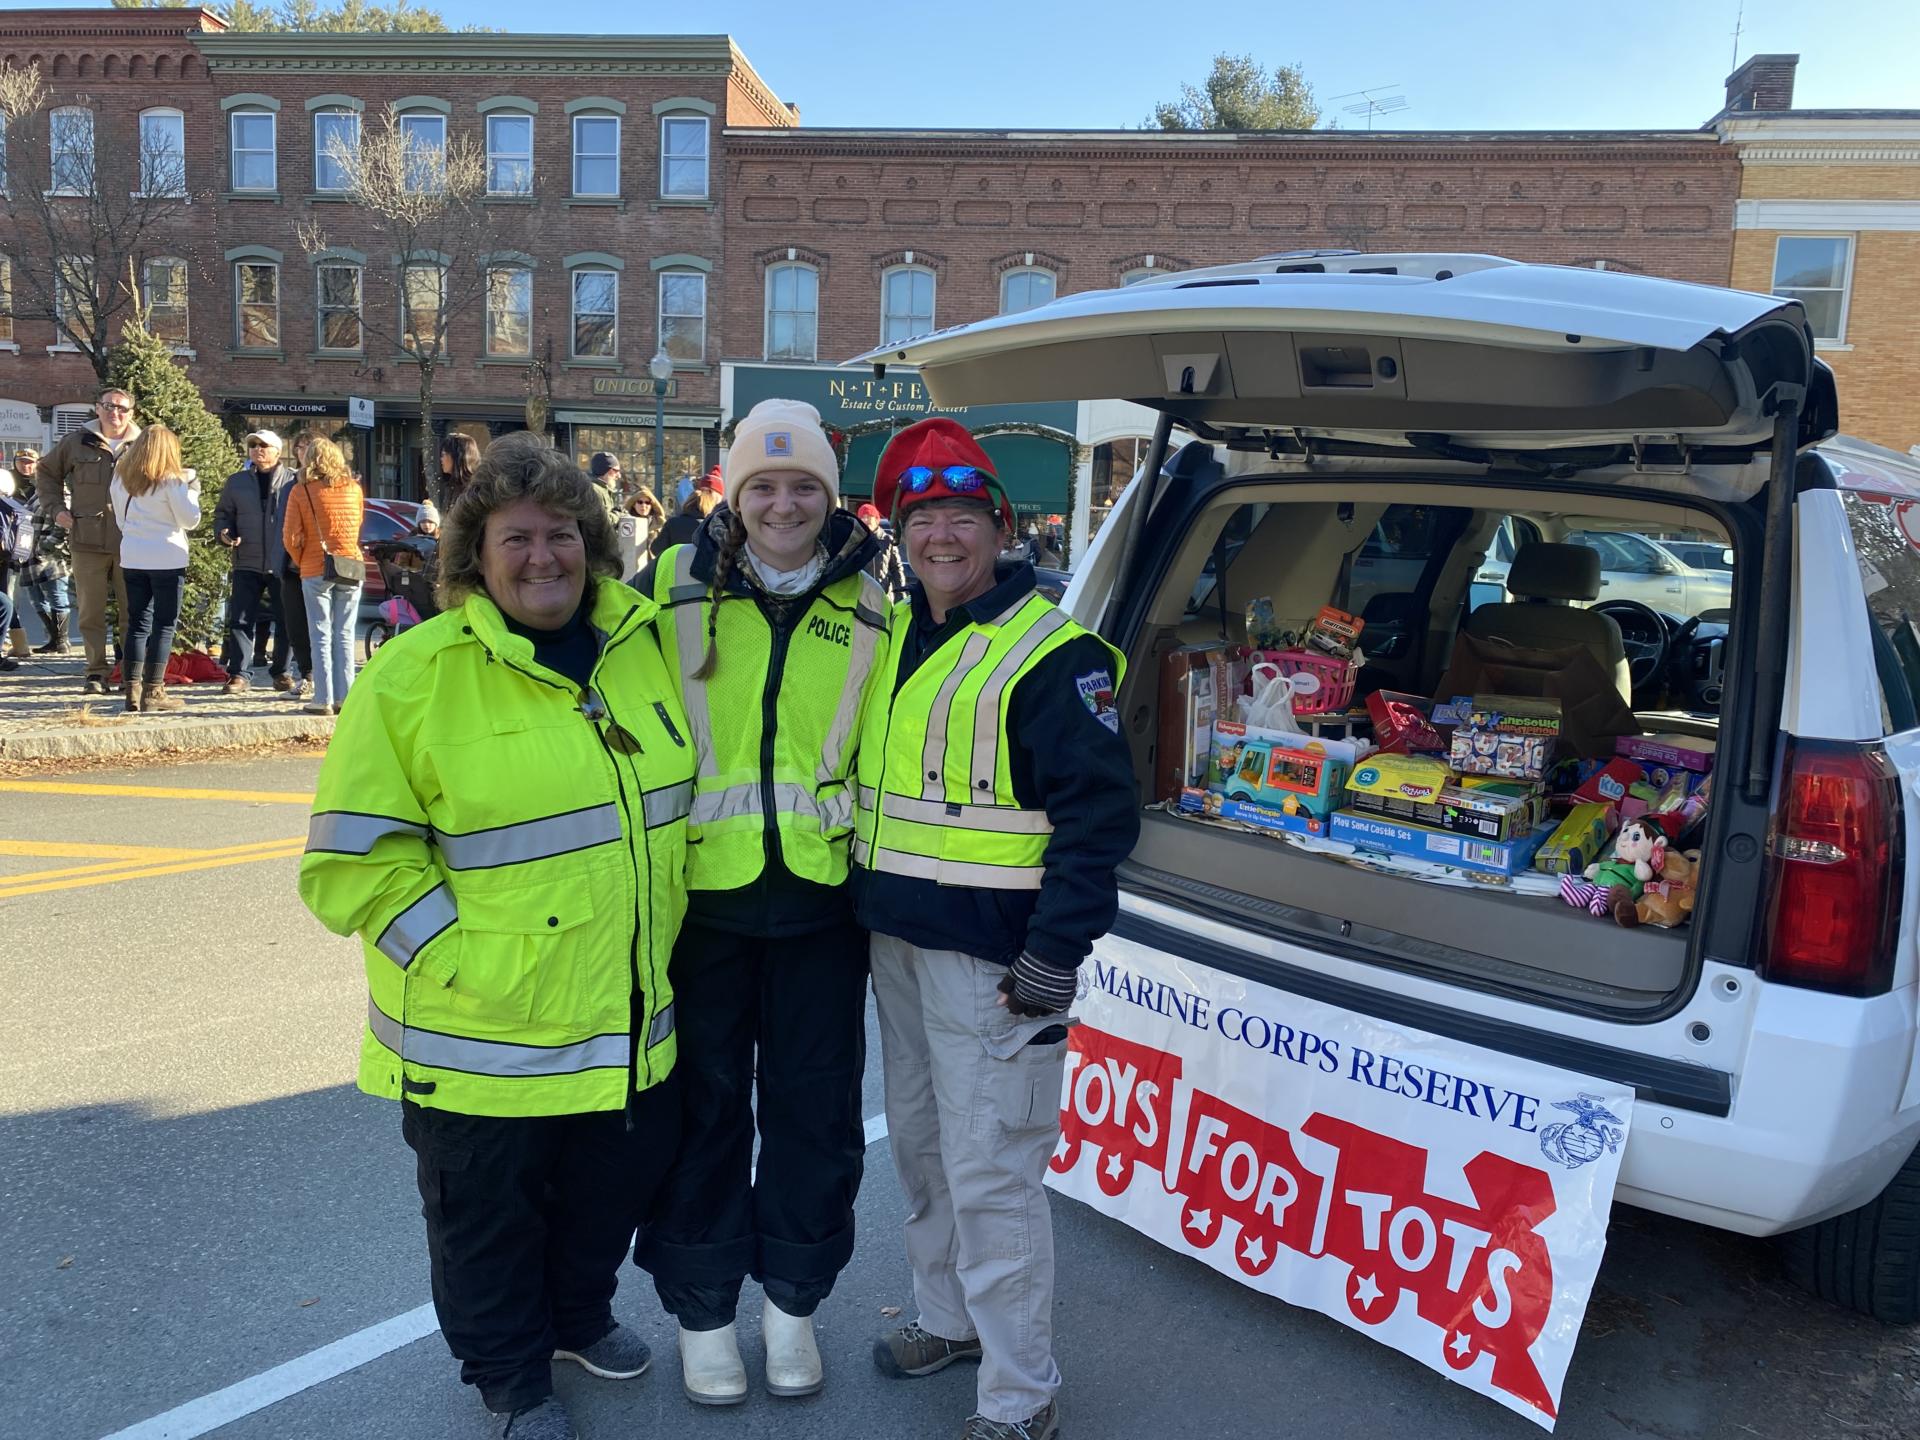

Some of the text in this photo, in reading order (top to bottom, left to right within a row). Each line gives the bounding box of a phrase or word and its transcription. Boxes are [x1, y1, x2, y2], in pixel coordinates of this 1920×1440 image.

[892, 382, 932, 400] FE
[250, 403, 327, 412] ELEVATION CLOTHING
[840, 398, 872, 410] Estate
[874, 399, 885, 410] &
[888, 400, 925, 412] Custom
[806, 614, 850, 648] POLICE
[1499, 716, 1559, 729] Dinosaur
[1360, 773, 1373, 782] 15
[1333, 816, 1412, 841] Play Sand Castle Set
[1092, 959, 1541, 1133] MARINE CORPS RESERVE
[1060, 1050, 1523, 1329] TOYS FOR TOTS
